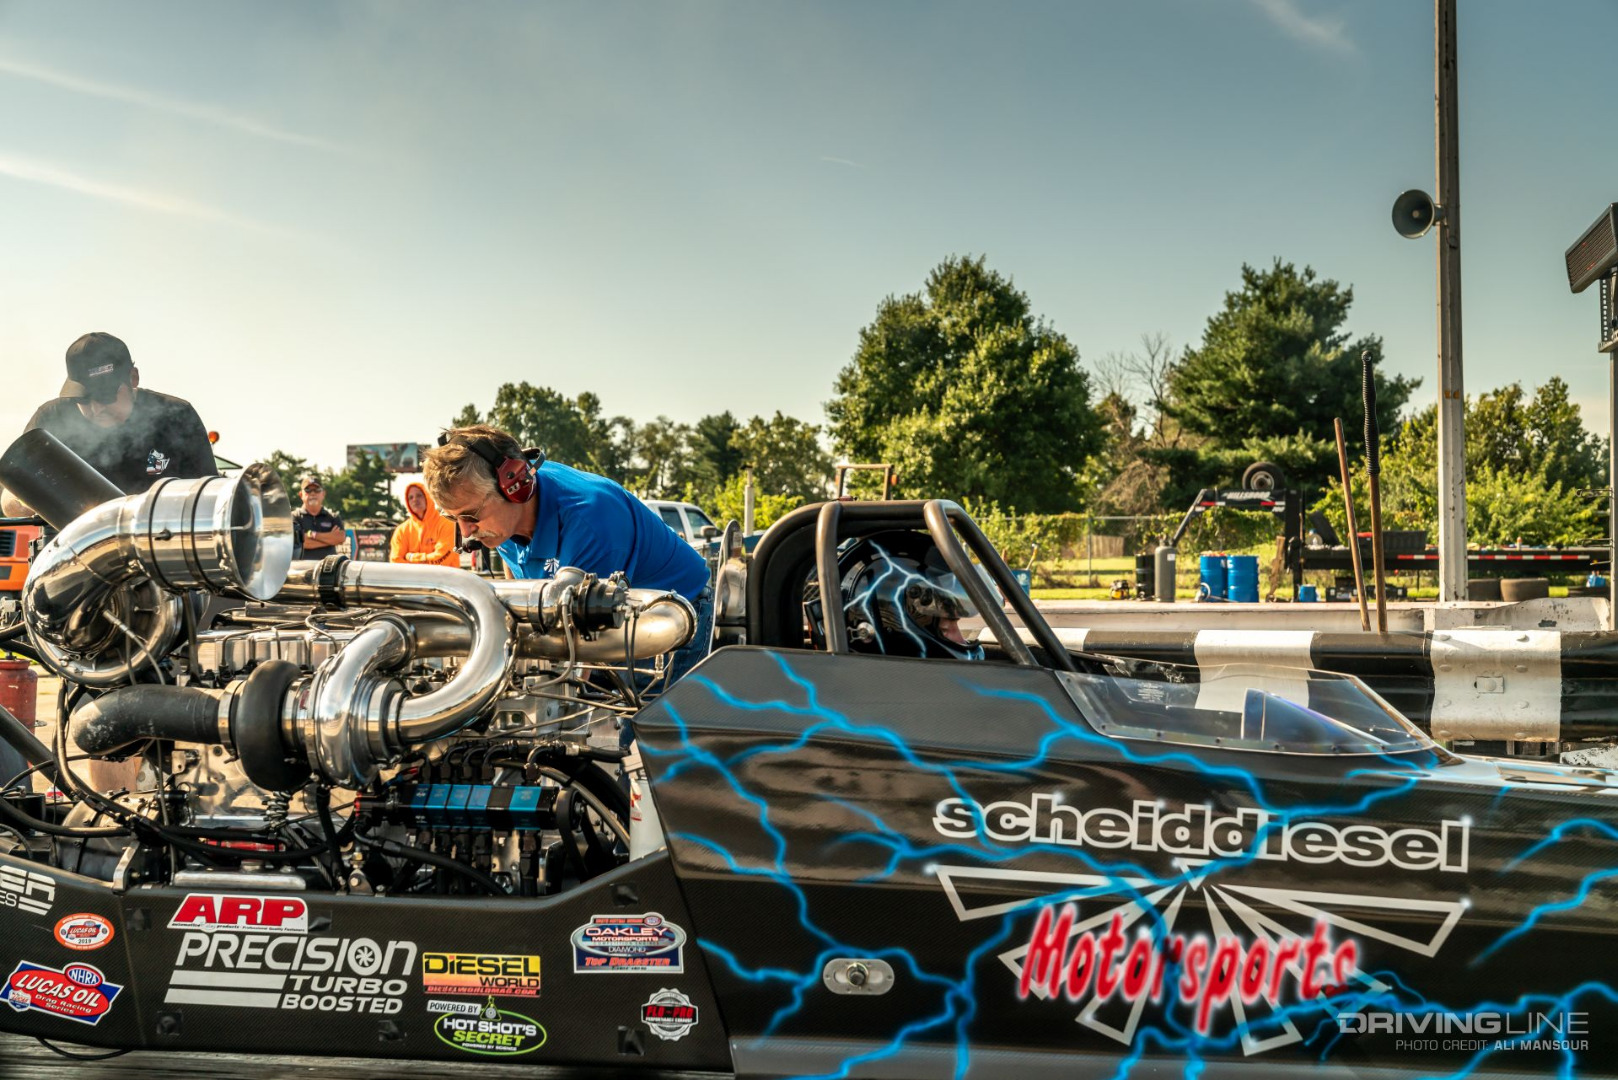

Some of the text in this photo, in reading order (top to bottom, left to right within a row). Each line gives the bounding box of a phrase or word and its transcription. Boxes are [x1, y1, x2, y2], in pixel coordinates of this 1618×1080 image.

[173, 896, 305, 926] ARP
[585, 927, 668, 936] OAKLEY
[71, 968, 98, 985] NHRA
[1018, 902, 1358, 1034] Motorsports
[15, 974, 101, 1007] LUCAS OIL
[289, 975, 408, 996] TURBO
[479, 977, 540, 988] WORLD
[35, 994, 58, 1004] Drag
[60, 1000, 92, 1013] Racing
[45, 1002, 75, 1014] Series
[281, 994, 403, 1014] BOOSTED
[429, 1002, 478, 1013] POWERED BY
[443, 1018, 537, 1036] HOT SHOT'S
[452, 1030, 525, 1047] SECRET
